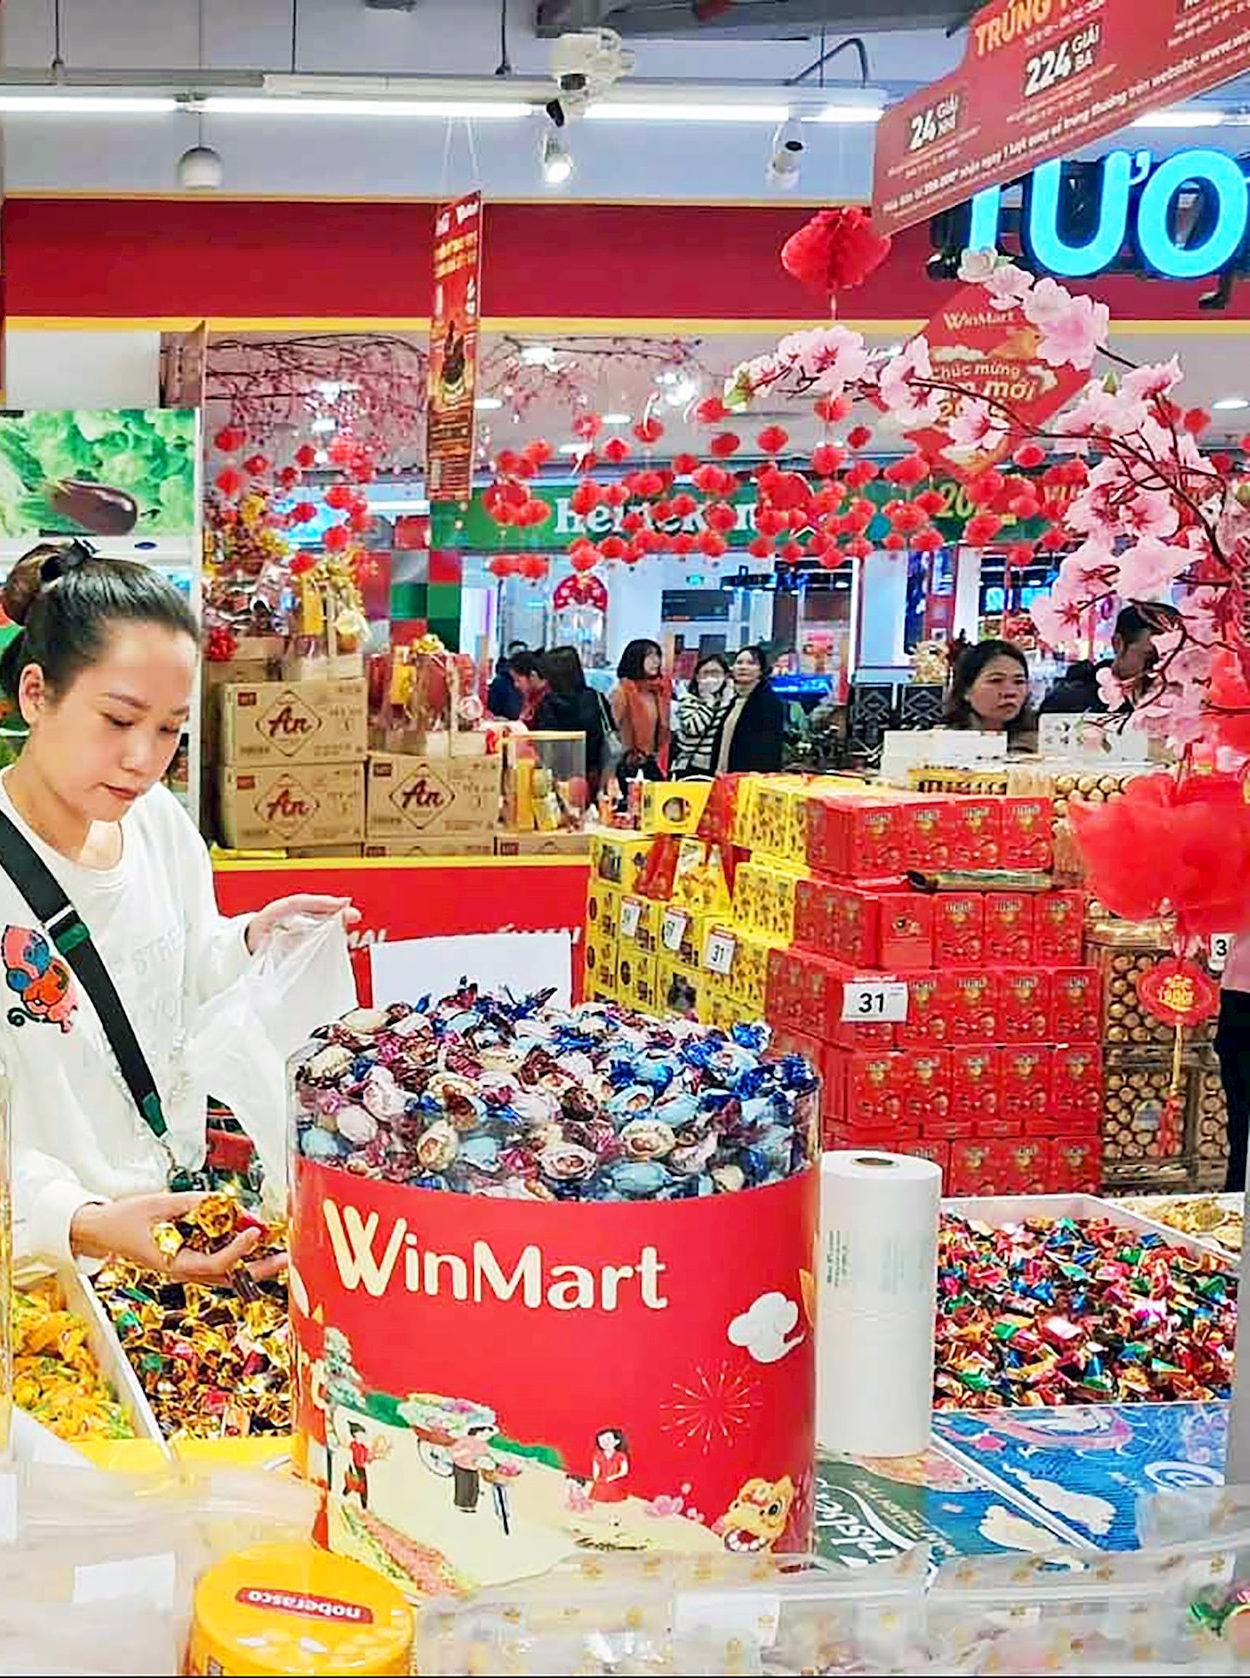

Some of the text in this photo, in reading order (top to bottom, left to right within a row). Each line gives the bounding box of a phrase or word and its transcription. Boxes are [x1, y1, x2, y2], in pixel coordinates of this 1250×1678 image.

[1024, 41, 1072, 97] 224
[909, 109, 938, 151] 24
[943, 311, 1014, 330] WinMart
[267, 705, 312, 737] An
[266, 788, 312, 820] An
[400, 779, 446, 809] An
[858, 992, 885, 1013] 31
[322, 1197, 669, 1311] WinMart
[247, 1589, 362, 1619] noberasco
